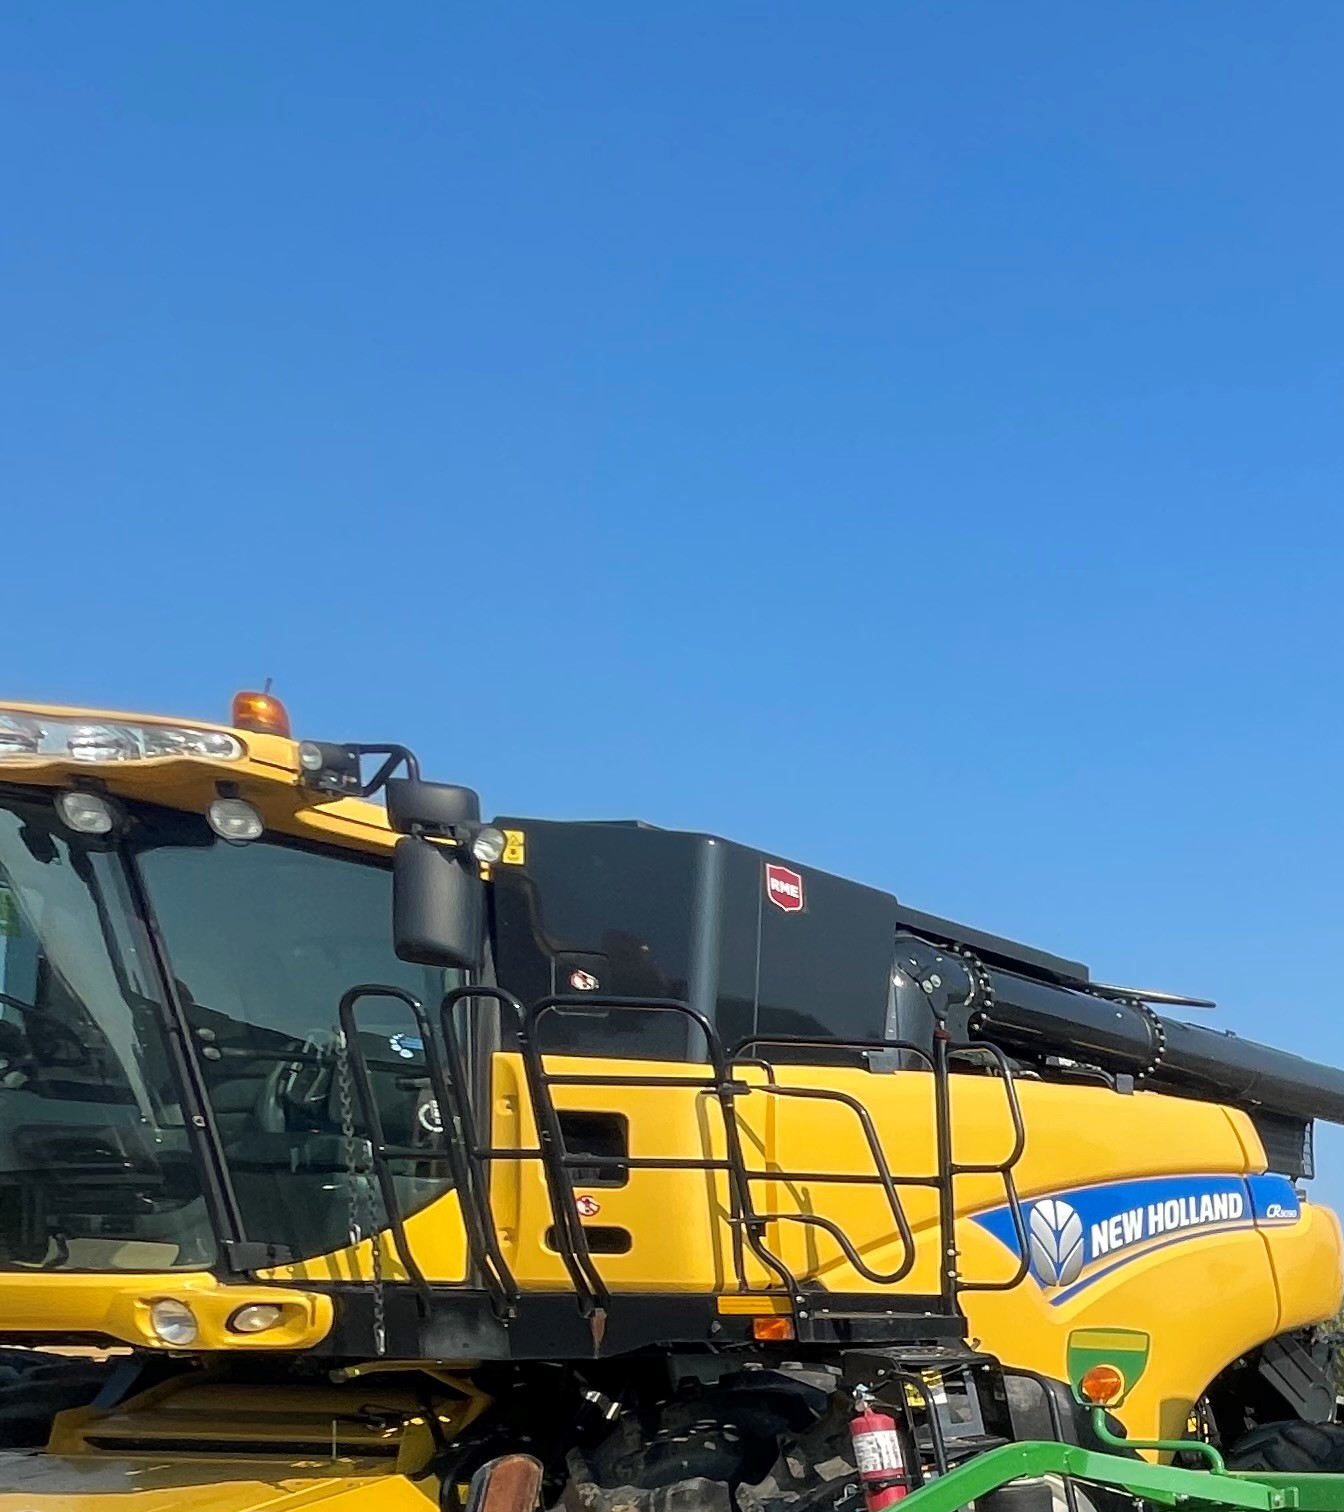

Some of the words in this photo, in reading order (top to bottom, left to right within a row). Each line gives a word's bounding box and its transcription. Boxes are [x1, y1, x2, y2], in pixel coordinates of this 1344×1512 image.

[770, 877, 800, 899] RME
[1091, 1208, 1143, 1258] NEW
[1148, 1193, 1243, 1236] HOLLAND
